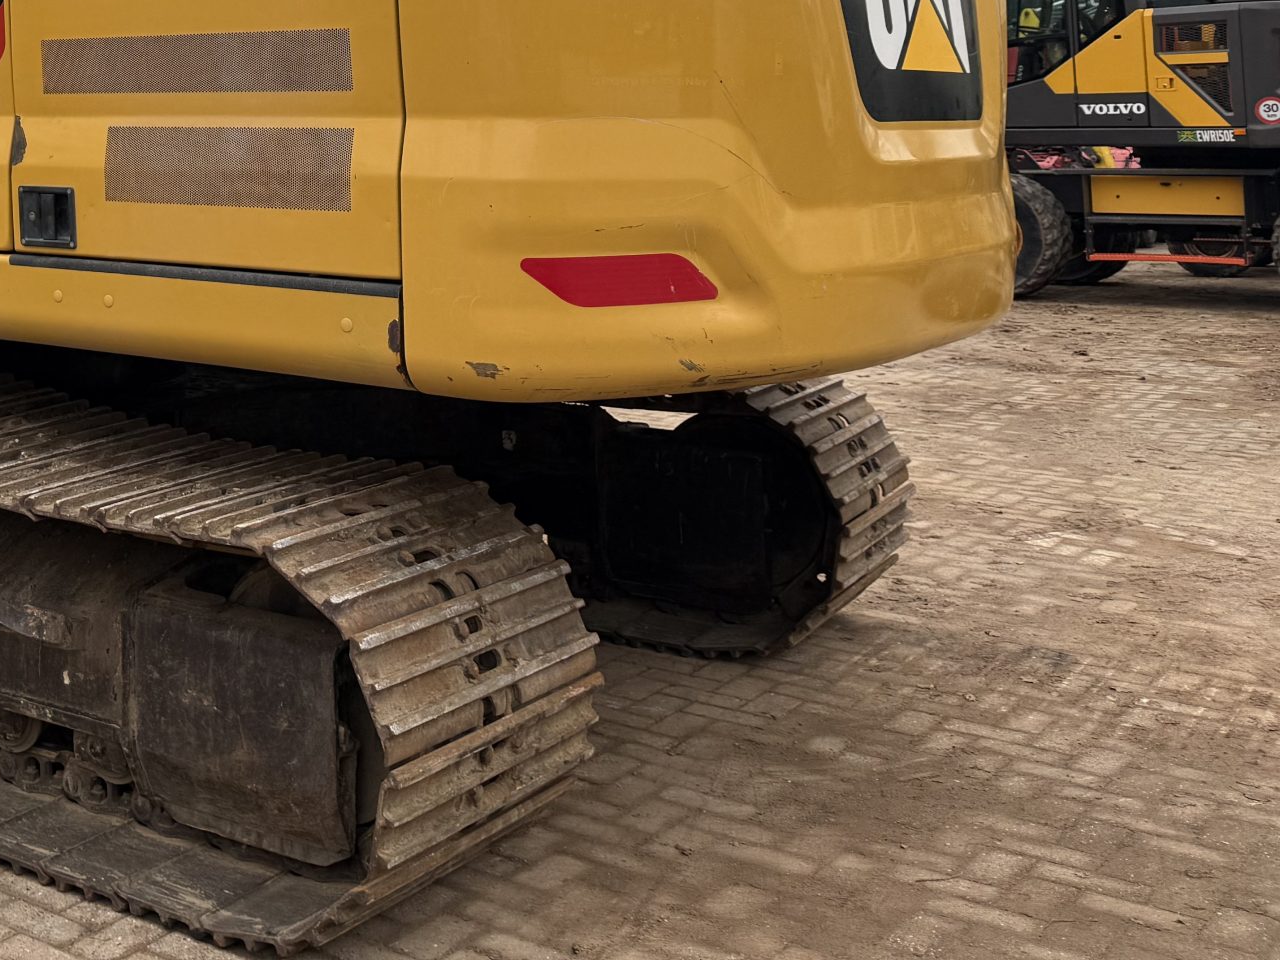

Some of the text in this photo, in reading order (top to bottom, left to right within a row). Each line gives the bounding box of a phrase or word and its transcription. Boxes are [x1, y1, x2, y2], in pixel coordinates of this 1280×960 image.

[1078, 103, 1146, 115] VOLVO
[1263, 103, 1279, 113] 30
[1196, 130, 1236, 142] EWR150E
